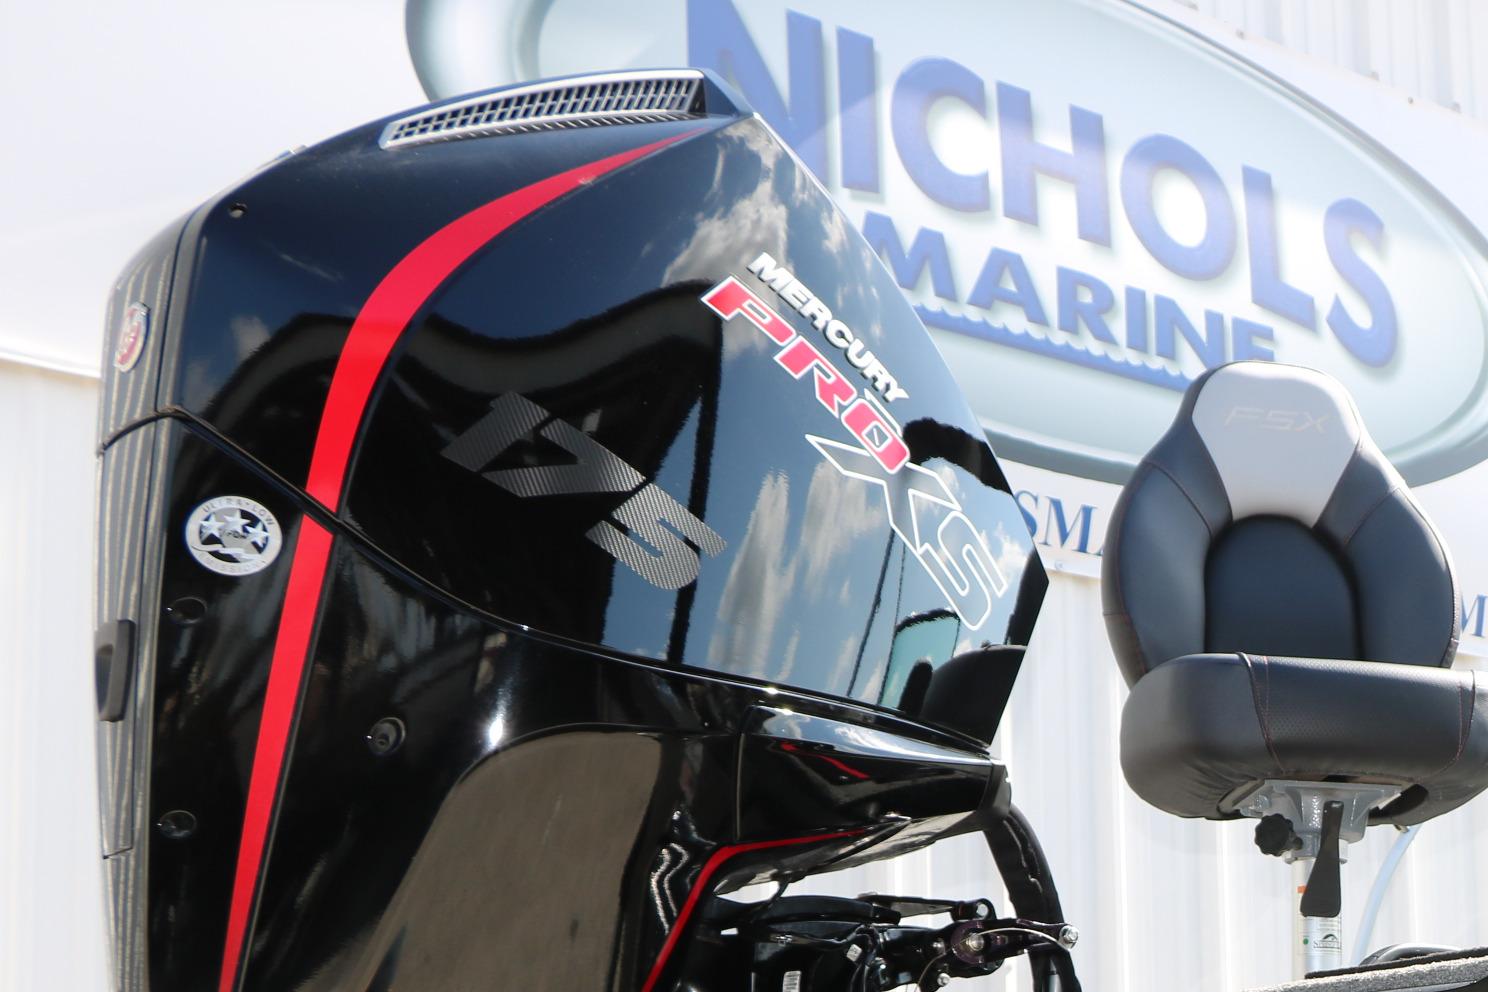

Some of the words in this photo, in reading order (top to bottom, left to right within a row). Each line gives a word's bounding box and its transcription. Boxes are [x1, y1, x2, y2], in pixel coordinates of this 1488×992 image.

[687, 0, 1399, 370] NICHOLS
[747, 252, 909, 402] MERCURY
[858, 211, 1275, 368] MARINE
[701, 274, 911, 473] PRO
[1224, 406, 1329, 433] FSX
